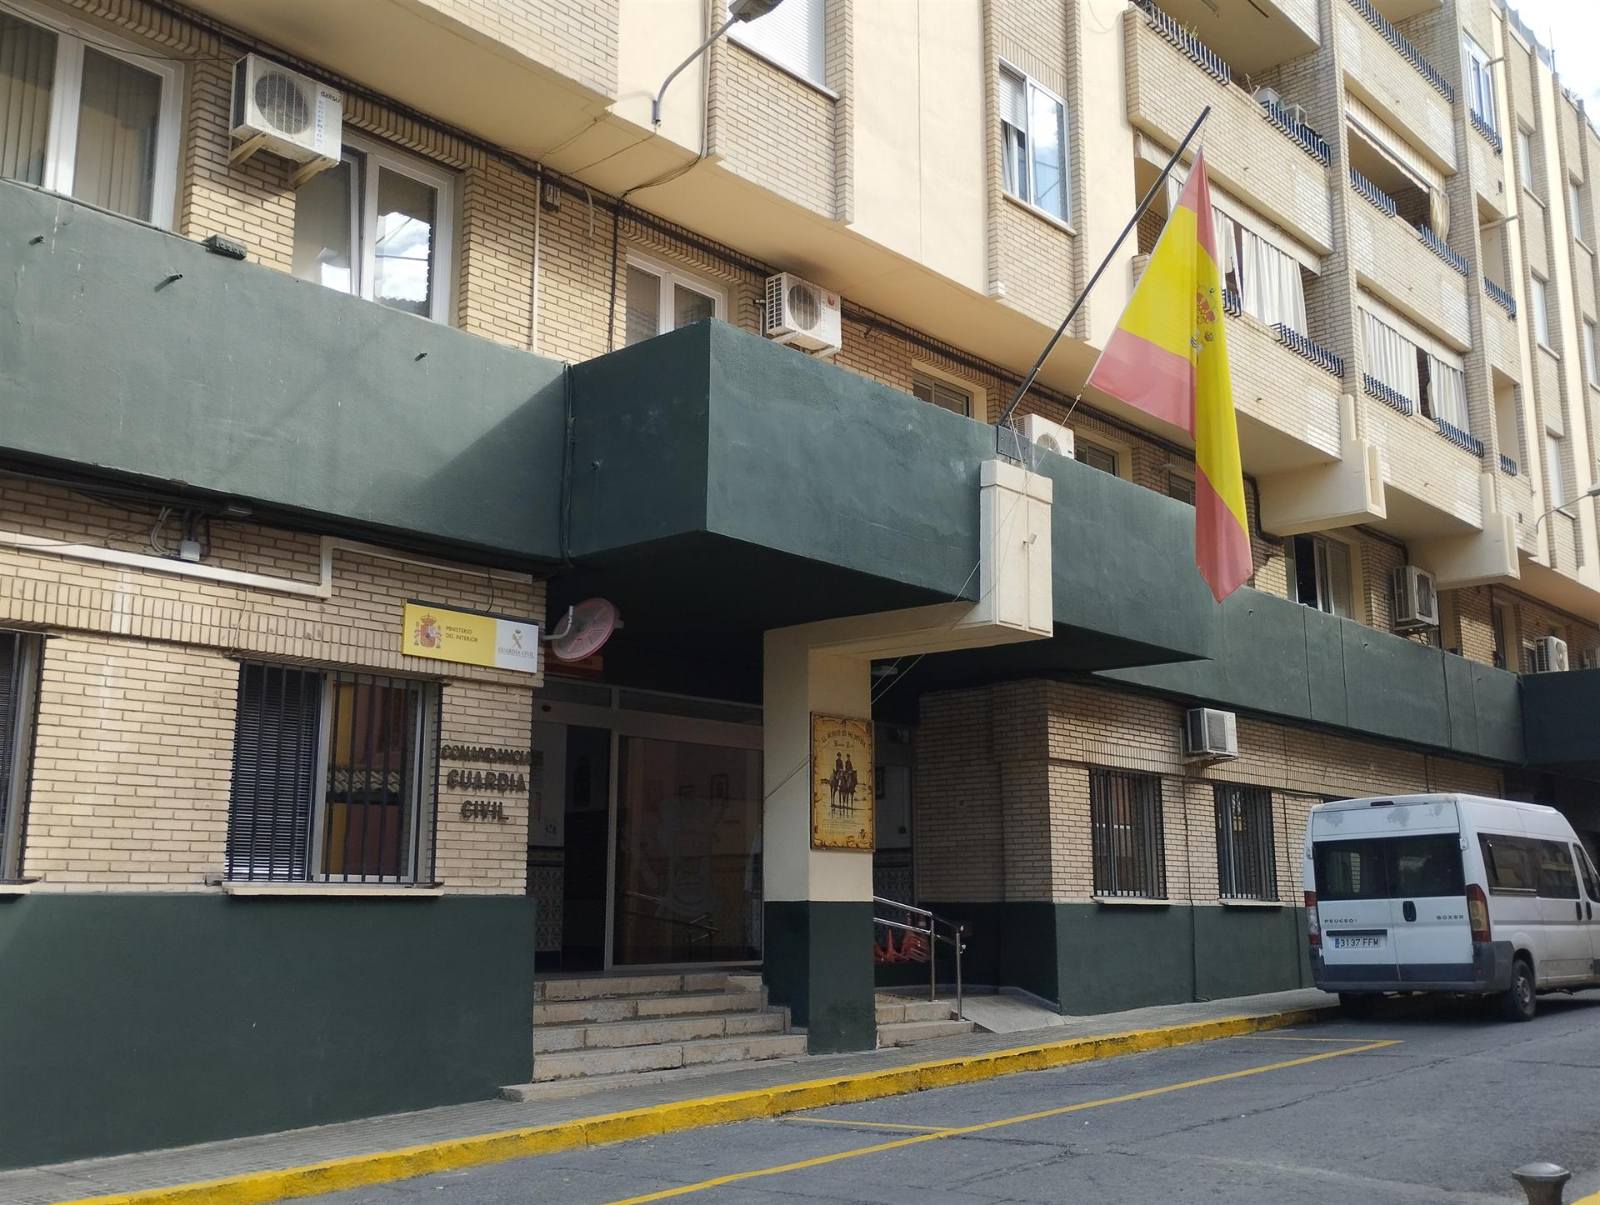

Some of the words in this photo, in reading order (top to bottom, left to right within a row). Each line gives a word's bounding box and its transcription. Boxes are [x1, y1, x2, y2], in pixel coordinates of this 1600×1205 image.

[445, 626, 473, 635] MINISTERIO
[455, 634, 478, 642] INTERIOR
[446, 769, 527, 793] GUARDIA
[461, 800, 509, 821] CIVIL
[1340, 938, 1360, 947] 3137
[1362, 938, 1379, 947] FFM
